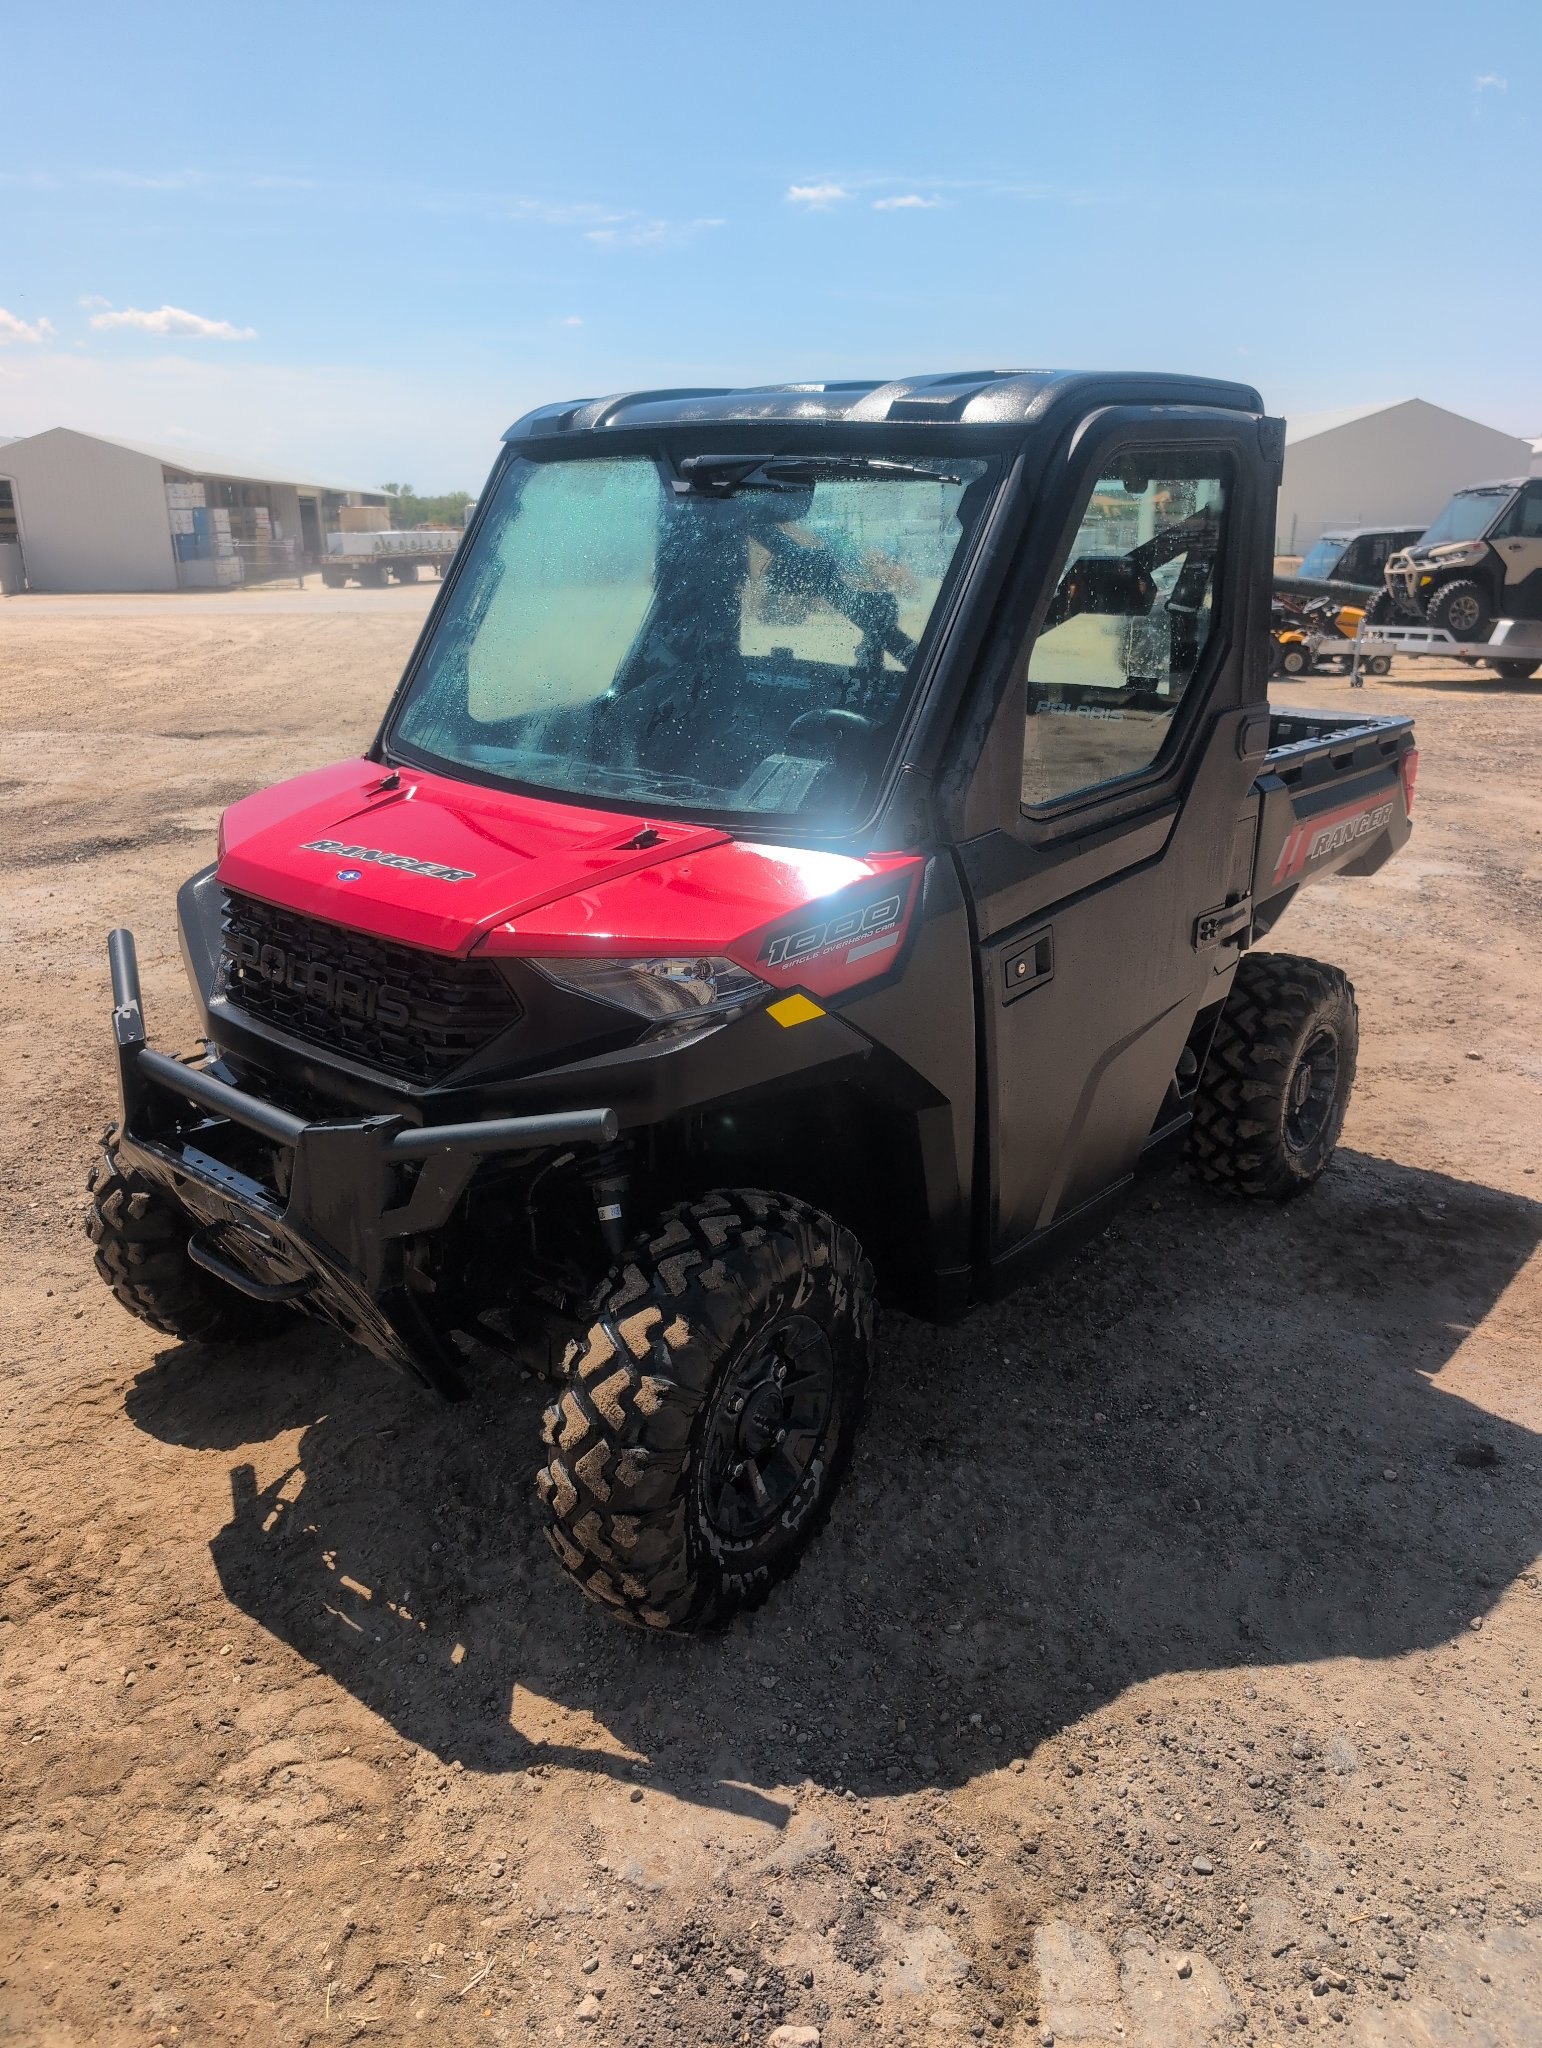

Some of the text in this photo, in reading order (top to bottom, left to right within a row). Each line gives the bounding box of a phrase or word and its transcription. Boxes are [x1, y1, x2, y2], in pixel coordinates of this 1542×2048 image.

[1035, 700, 1125, 722] POLARIS
[1310, 802, 1393, 860] RANGER
[299, 839, 476, 882] RANGER
[767, 895, 900, 967] 1000
[782, 922, 896, 971] SINGLE OVERHEAD CAM
[238, 933, 410, 1029] POLARIS
